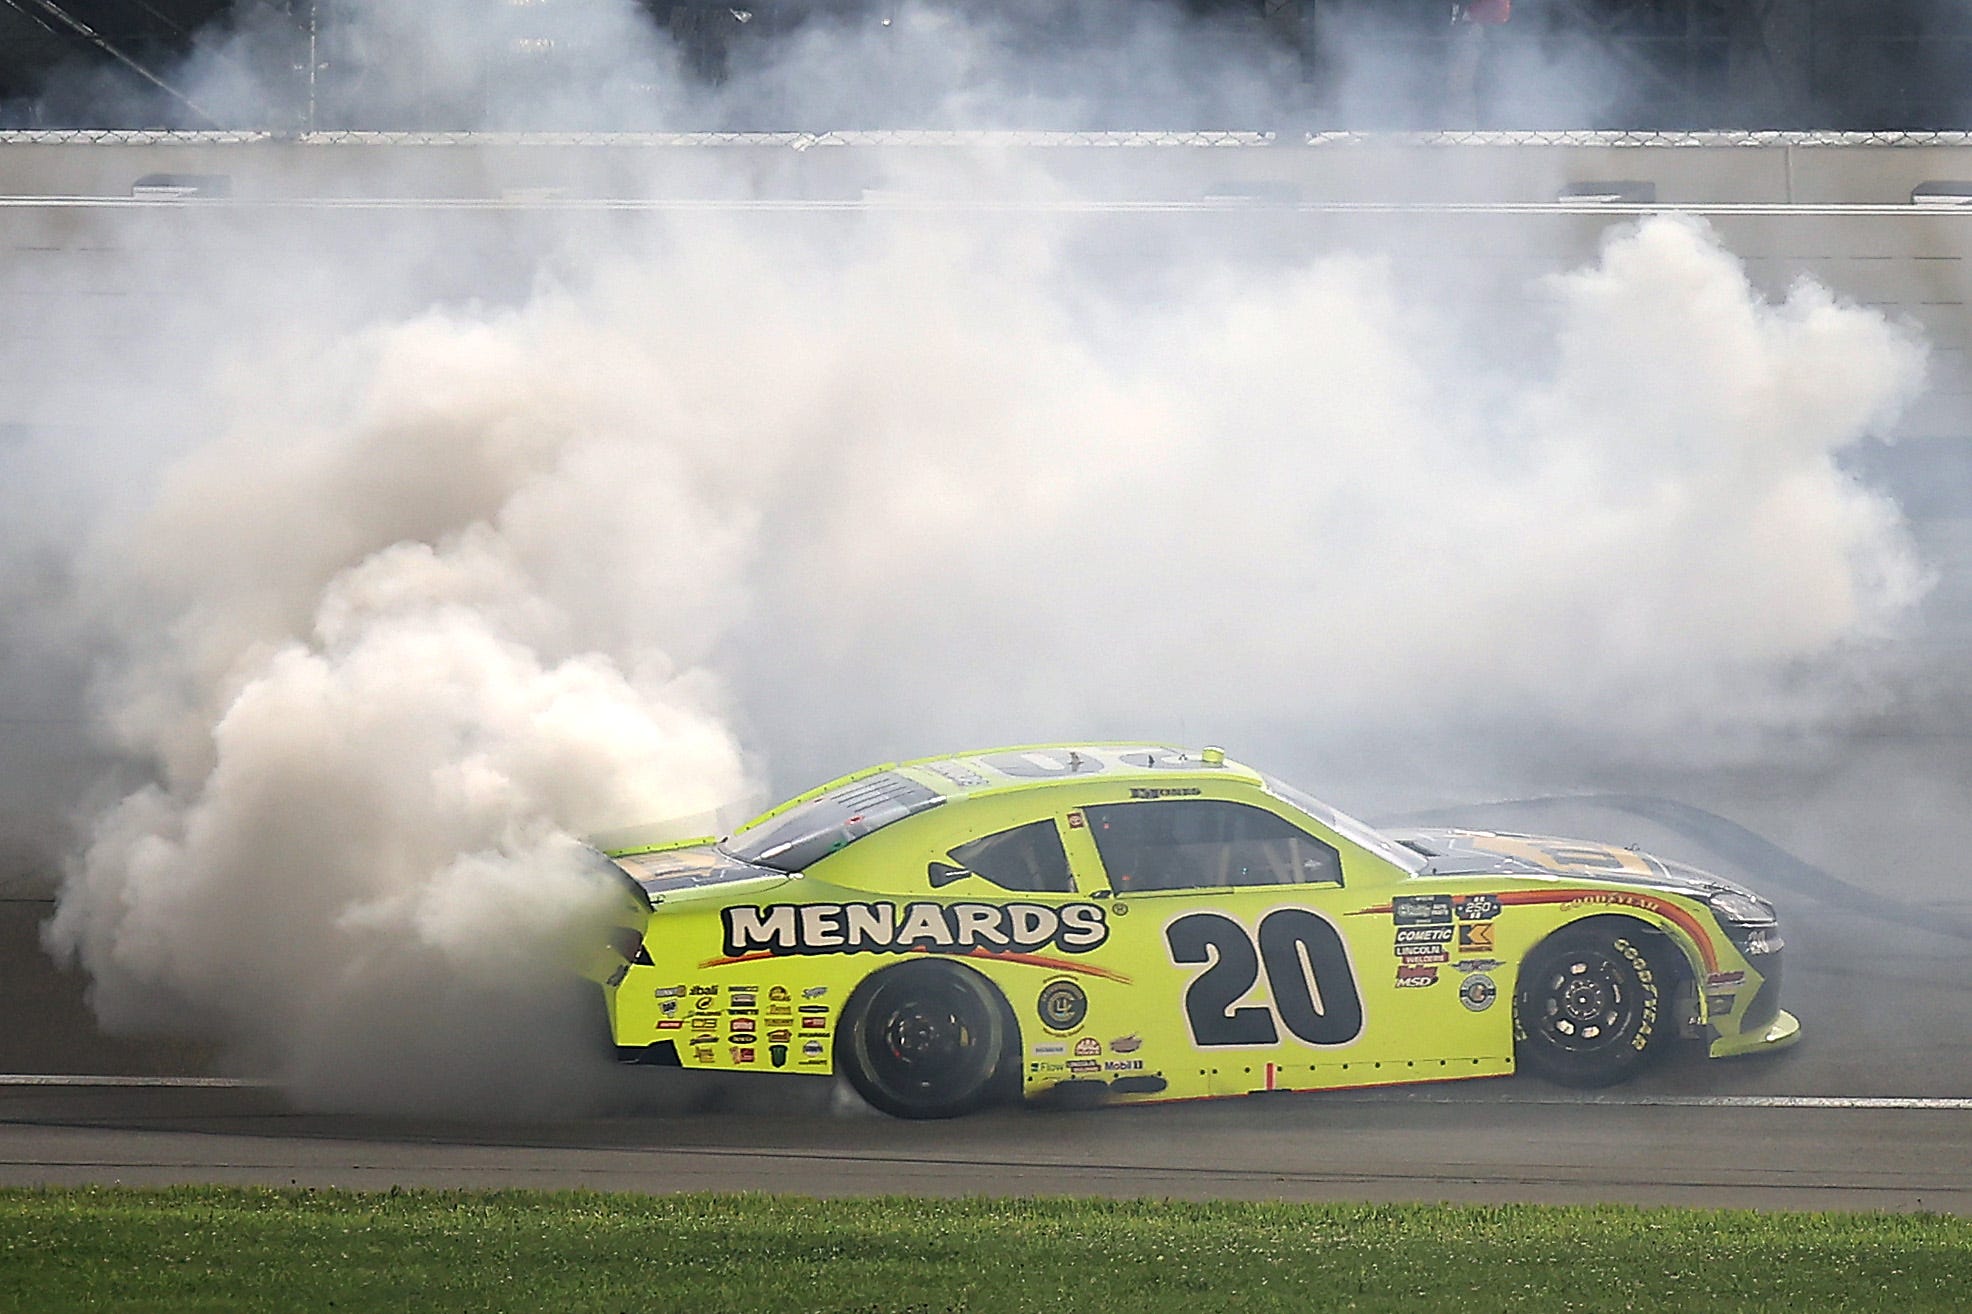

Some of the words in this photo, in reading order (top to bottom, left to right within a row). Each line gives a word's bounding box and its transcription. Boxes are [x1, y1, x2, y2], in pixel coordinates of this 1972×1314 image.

[1465, 902, 1492, 913] 250
[1559, 892, 1659, 912] GOODYEAR
[723, 902, 1108, 955] MENARDS
[1397, 929, 1452, 942] COMETIC
[1396, 945, 1440, 956] LINCOLN
[1165, 908, 1364, 1046] 20
[1396, 977, 1432, 988] MSD
[1613, 938, 1659, 1051] GOODYEAR
[1104, 1060, 1132, 1071] Mobil
